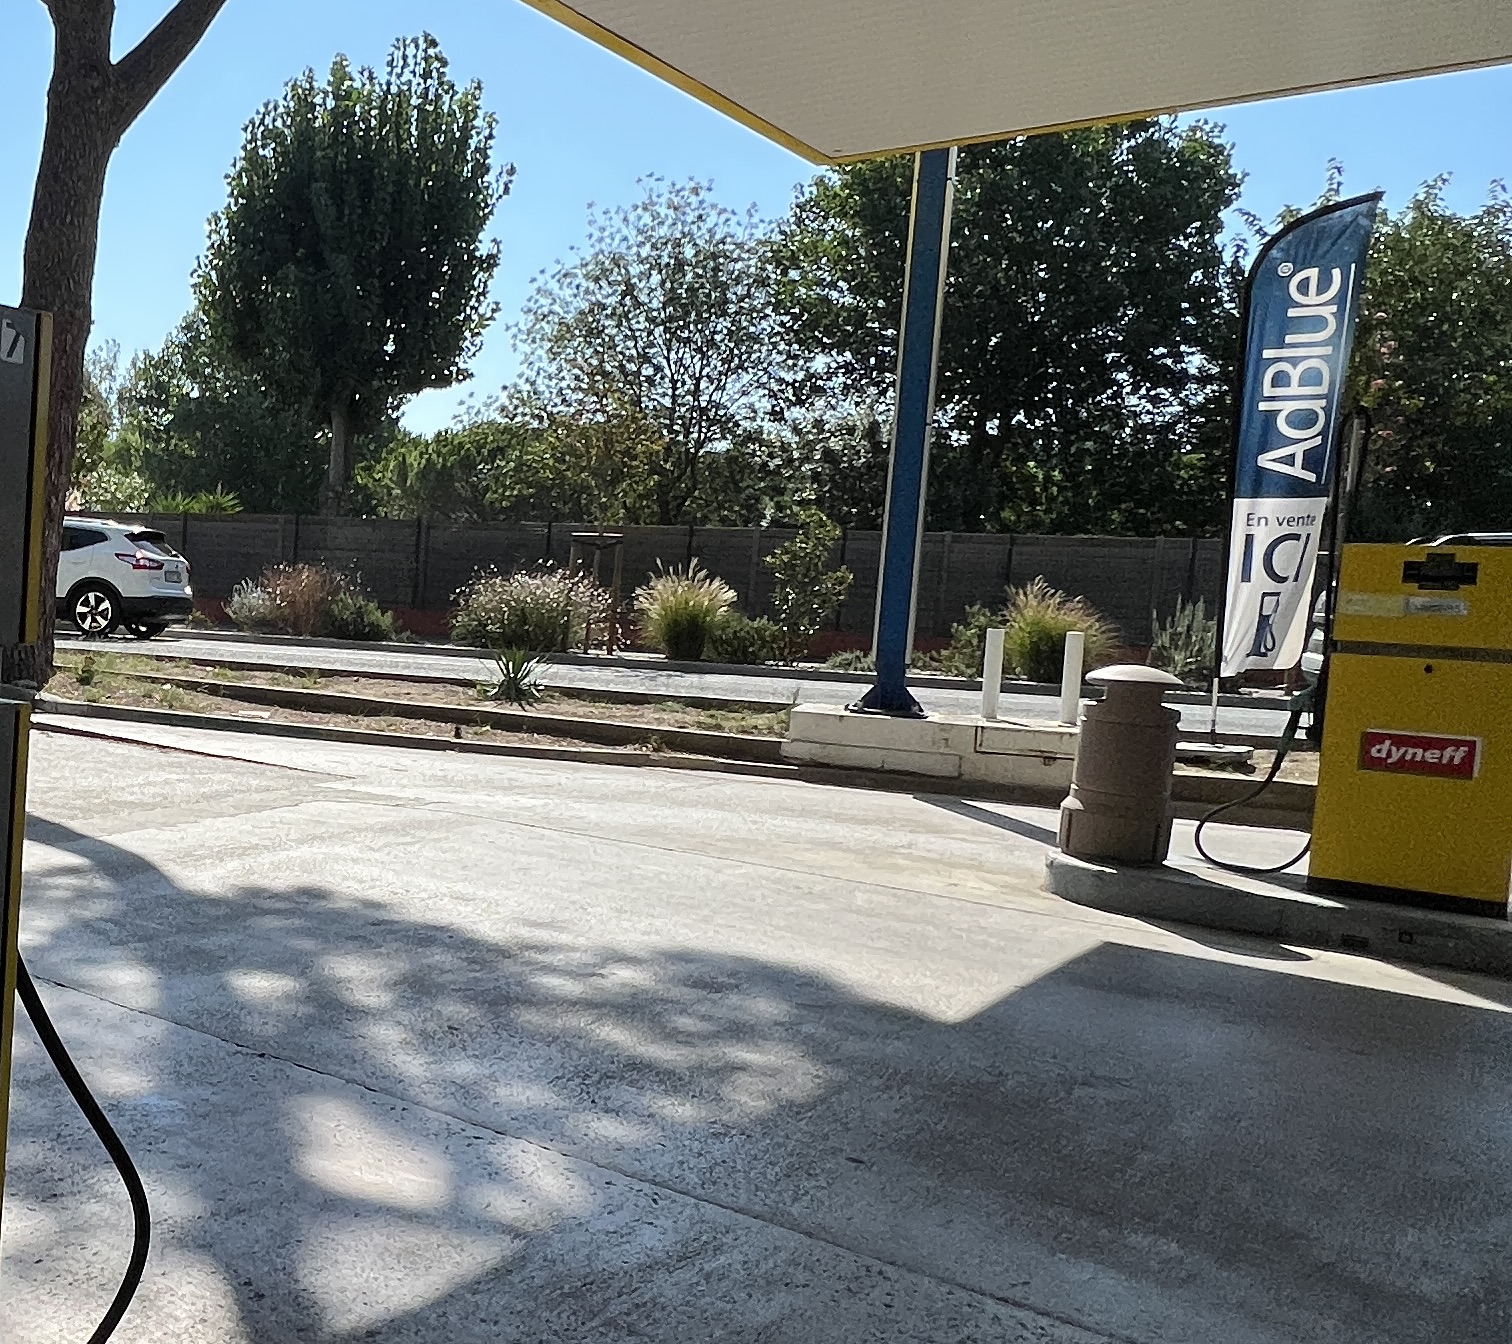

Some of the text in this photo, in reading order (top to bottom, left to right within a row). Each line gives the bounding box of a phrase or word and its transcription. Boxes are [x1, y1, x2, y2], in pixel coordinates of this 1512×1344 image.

[6, 321, 21, 358] 7
[1246, 513, 1317, 528] En vente
[1241, 533, 1311, 584] ICI
[1370, 739, 1469, 765] dyneff
